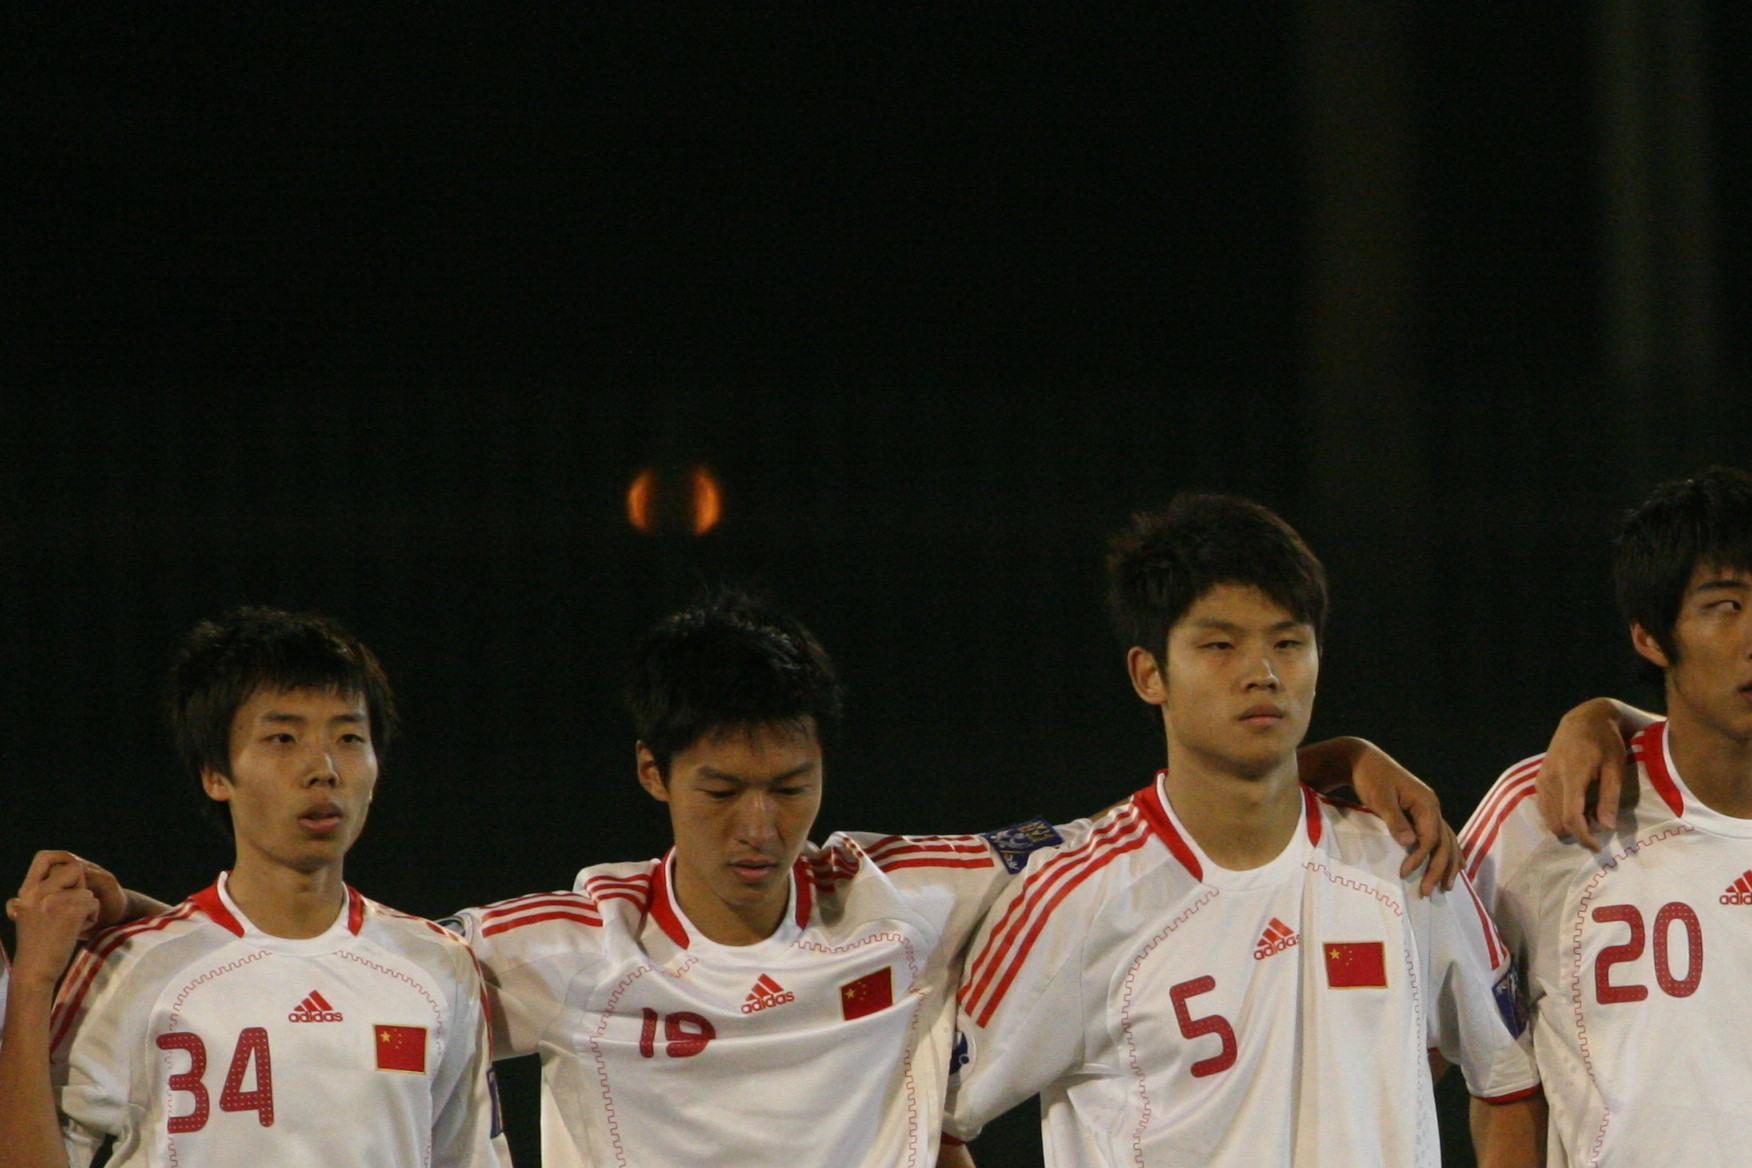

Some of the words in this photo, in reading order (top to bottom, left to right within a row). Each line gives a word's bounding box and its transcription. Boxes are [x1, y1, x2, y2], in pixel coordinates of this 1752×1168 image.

[1591, 901, 1704, 1005] 20
[288, 1008, 343, 1023] adidas
[638, 1006, 717, 1059] 19
[741, 985, 795, 1014] adidas
[1168, 974, 1238, 1079] 5
[155, 1025, 274, 1134] 34
